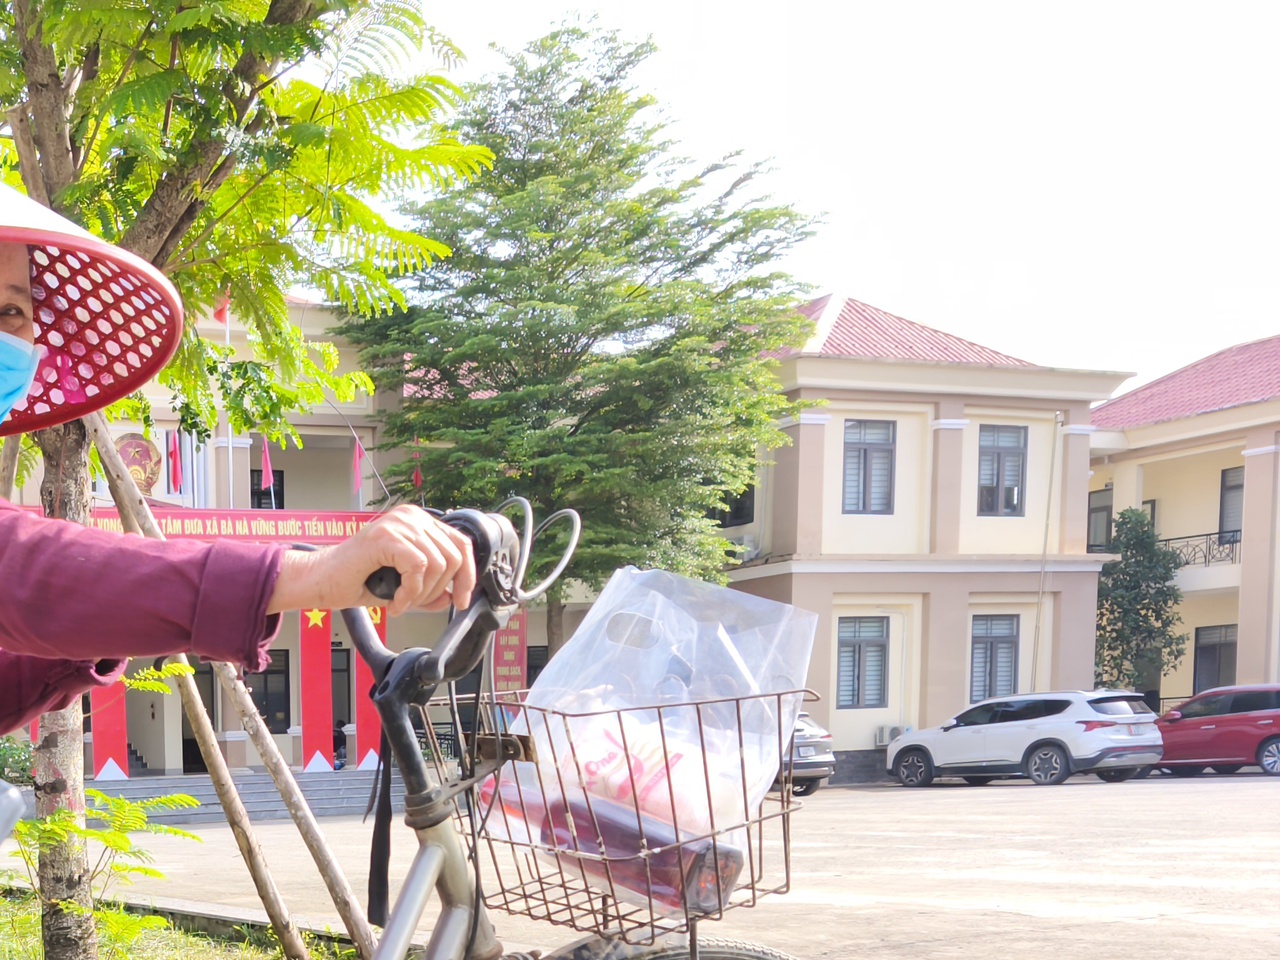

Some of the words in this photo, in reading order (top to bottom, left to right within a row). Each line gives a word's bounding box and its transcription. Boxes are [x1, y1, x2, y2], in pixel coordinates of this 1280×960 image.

[161, 516, 182, 535] TÂM
[184, 517, 204, 535] ĐƯA
[206, 516, 219, 535] XÃ
[221, 516, 234, 536] BÀ
[236, 517, 249, 536] NÀ
[251, 517, 275, 536] VỮNG
[278, 517, 302, 537] BƯỚC
[304, 516, 324, 537] TIẾN
[326, 517, 344, 537] VÀO
